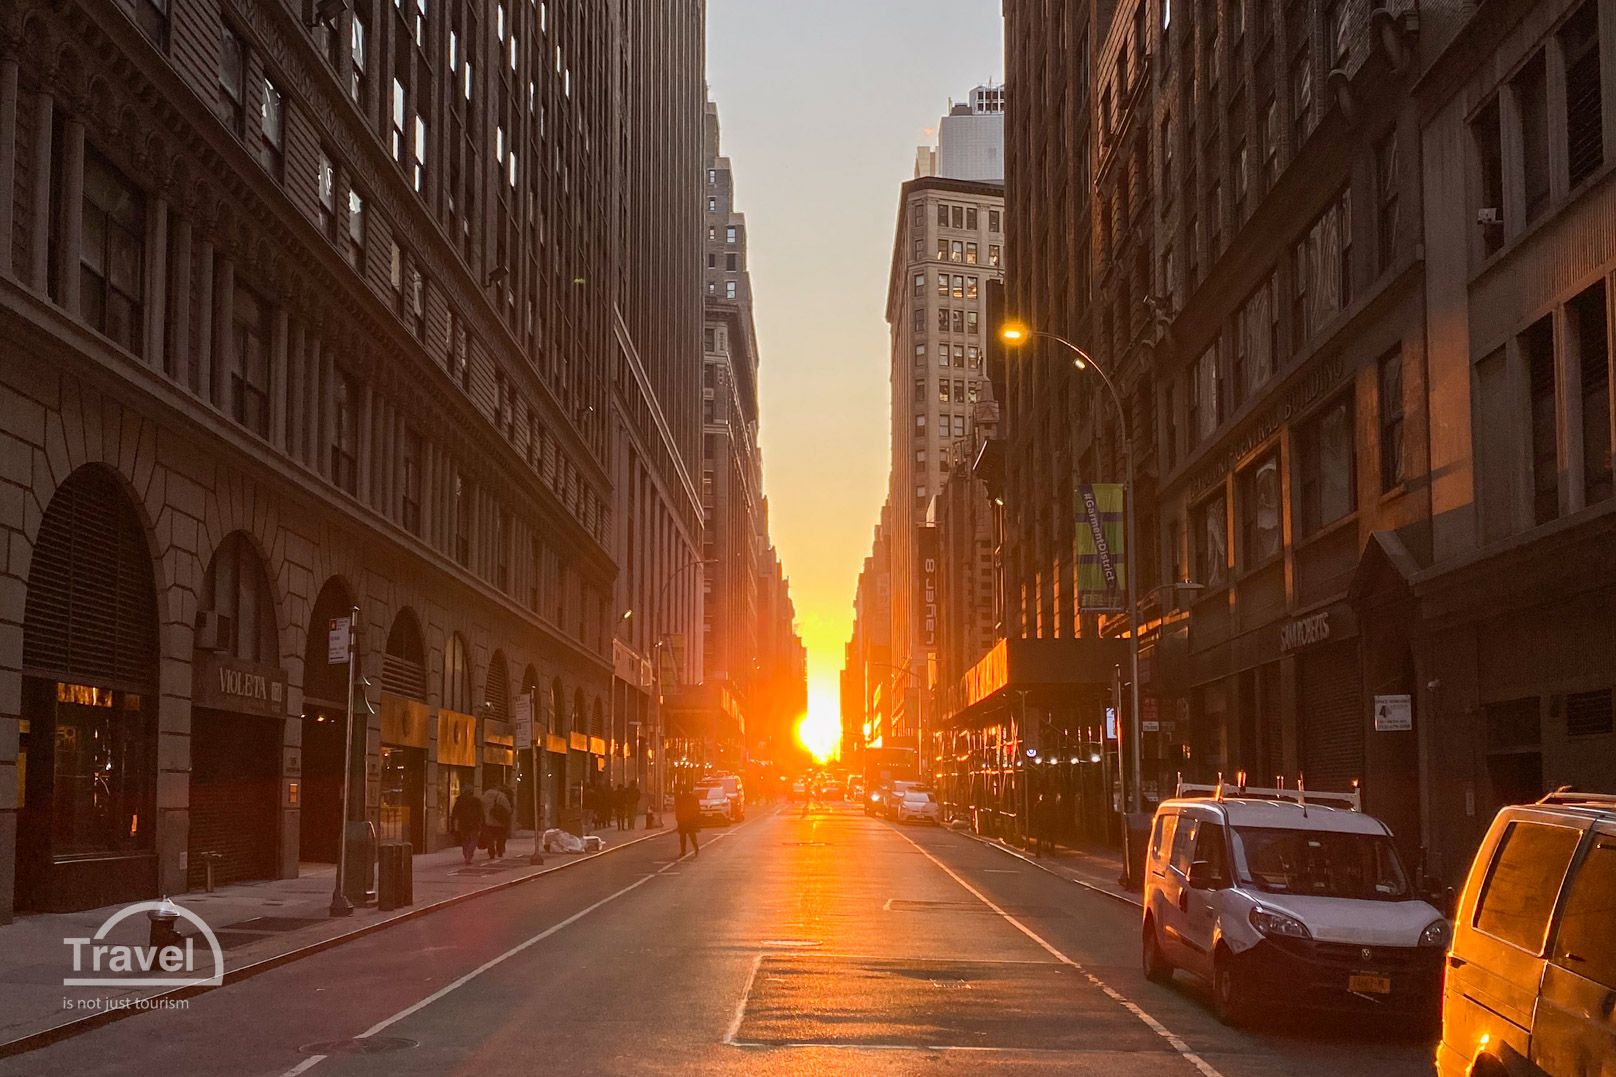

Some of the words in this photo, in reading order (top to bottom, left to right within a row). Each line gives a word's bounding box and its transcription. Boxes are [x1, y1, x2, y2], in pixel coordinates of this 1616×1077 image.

[1083, 492, 1115, 582] #GarmentDistrict
[924, 557, 935, 573] 8
[925, 578, 937, 645] Layer
[219, 666, 267, 700] VIOLETA
